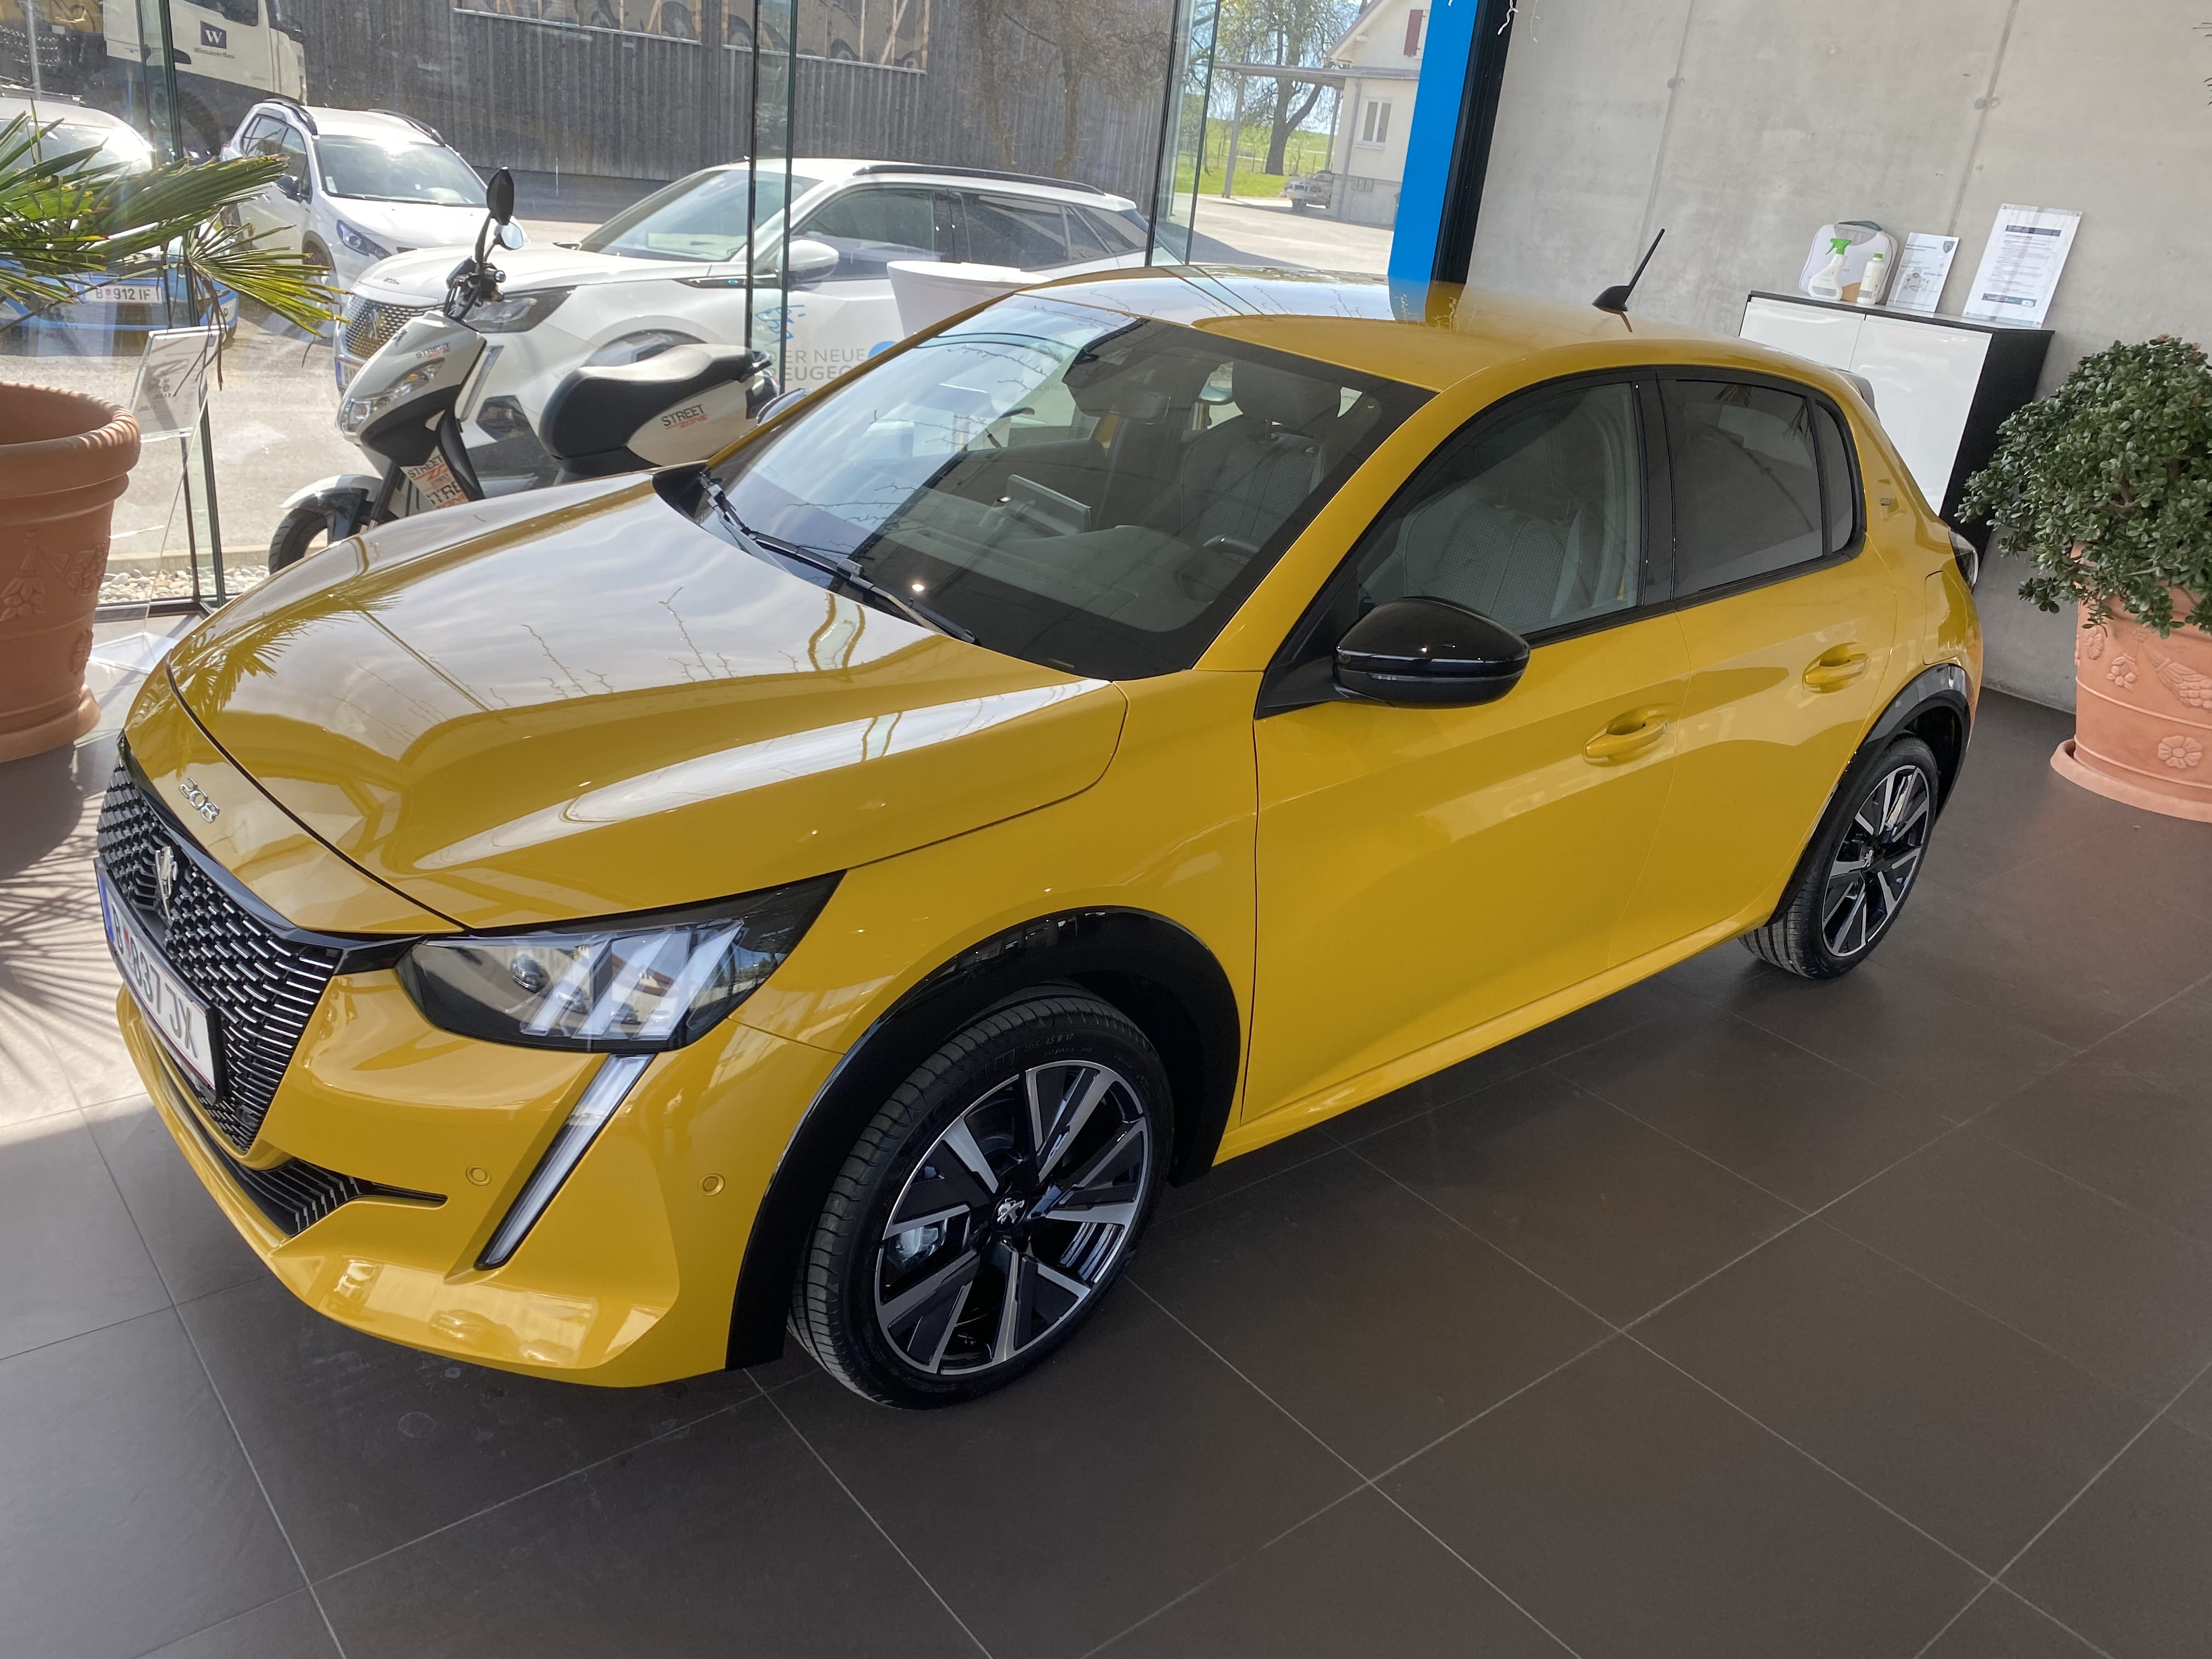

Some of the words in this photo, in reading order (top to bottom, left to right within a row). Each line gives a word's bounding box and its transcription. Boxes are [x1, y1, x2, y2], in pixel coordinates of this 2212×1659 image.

[205, 30, 222, 44] W
[95, 290, 103, 299] B
[113, 288, 136, 300] 912
[139, 289, 150, 300] IF
[815, 348, 865, 363] NEUE
[661, 404, 704, 426] STREET
[178, 778, 219, 823] 208
[111, 902, 124, 956] B
[129, 935, 161, 1014] 837
[166, 983, 197, 1059] JX
